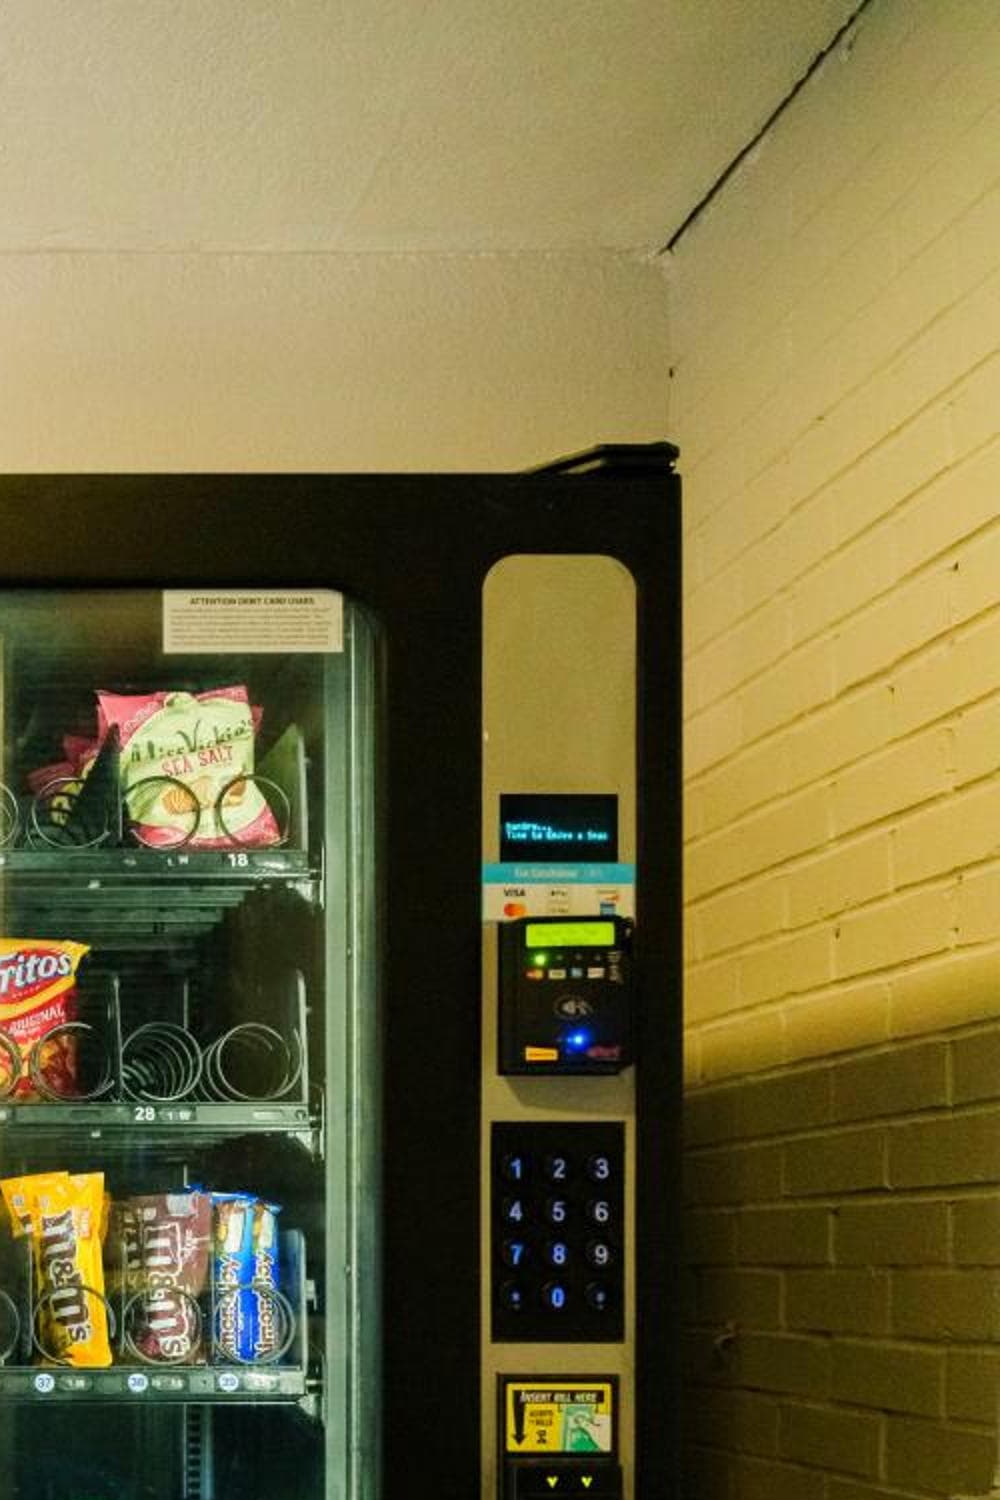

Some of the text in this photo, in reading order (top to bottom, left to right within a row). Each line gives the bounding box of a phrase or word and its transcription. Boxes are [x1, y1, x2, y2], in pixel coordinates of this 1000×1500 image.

[190, 597, 236, 606] ATTENTION
[264, 597, 286, 606] CARD
[198, 745, 234, 768] SALT
[228, 853, 249, 867] 18
[134, 1107, 155, 1121] 28
[510, 1159, 522, 1179] 1
[552, 1159, 566, 1179] 2
[594, 1158, 610, 1179] 3
[509, 1201, 523, 1222] 4
[552, 1201, 566, 1222] 5
[594, 1201, 609, 1222] 6
[510, 1244, 523, 1265] 7
[552, 1244, 566, 1264] 8
[594, 1244, 609, 1265] 9
[551, 1287, 565, 1308] 0
